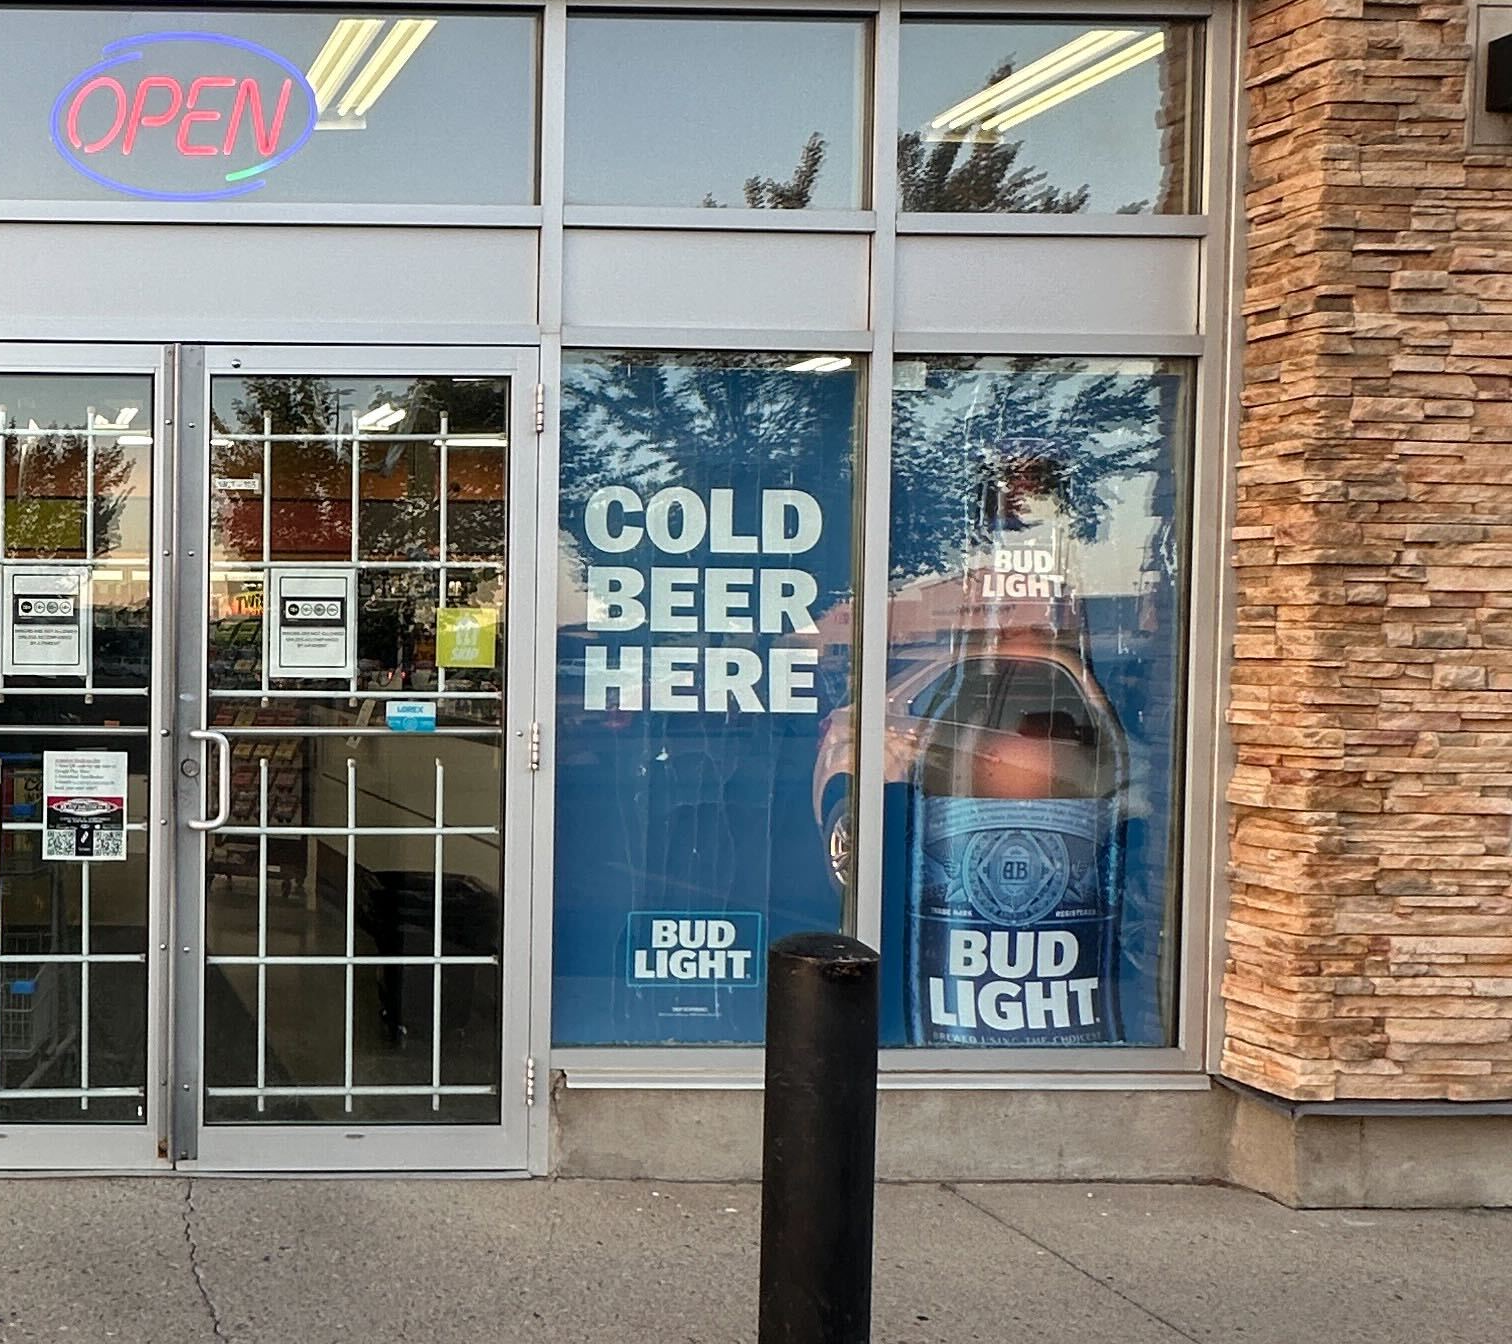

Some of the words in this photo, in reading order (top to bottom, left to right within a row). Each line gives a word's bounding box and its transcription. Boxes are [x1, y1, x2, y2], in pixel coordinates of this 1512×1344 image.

[66, 76, 293, 156] OPEN
[584, 485, 823, 554] COLD
[982, 573, 1066, 598] LIGHT
[994, 549, 1054, 574] BUD
[586, 566, 820, 634] BEER
[584, 645, 819, 714] HERE
[396, 706, 424, 714] LOREX
[652, 919, 737, 949] BUD
[948, 929, 1080, 979] BUD
[634, 949, 752, 979] LIGHT
[929, 977, 1100, 1031] LIGHT
